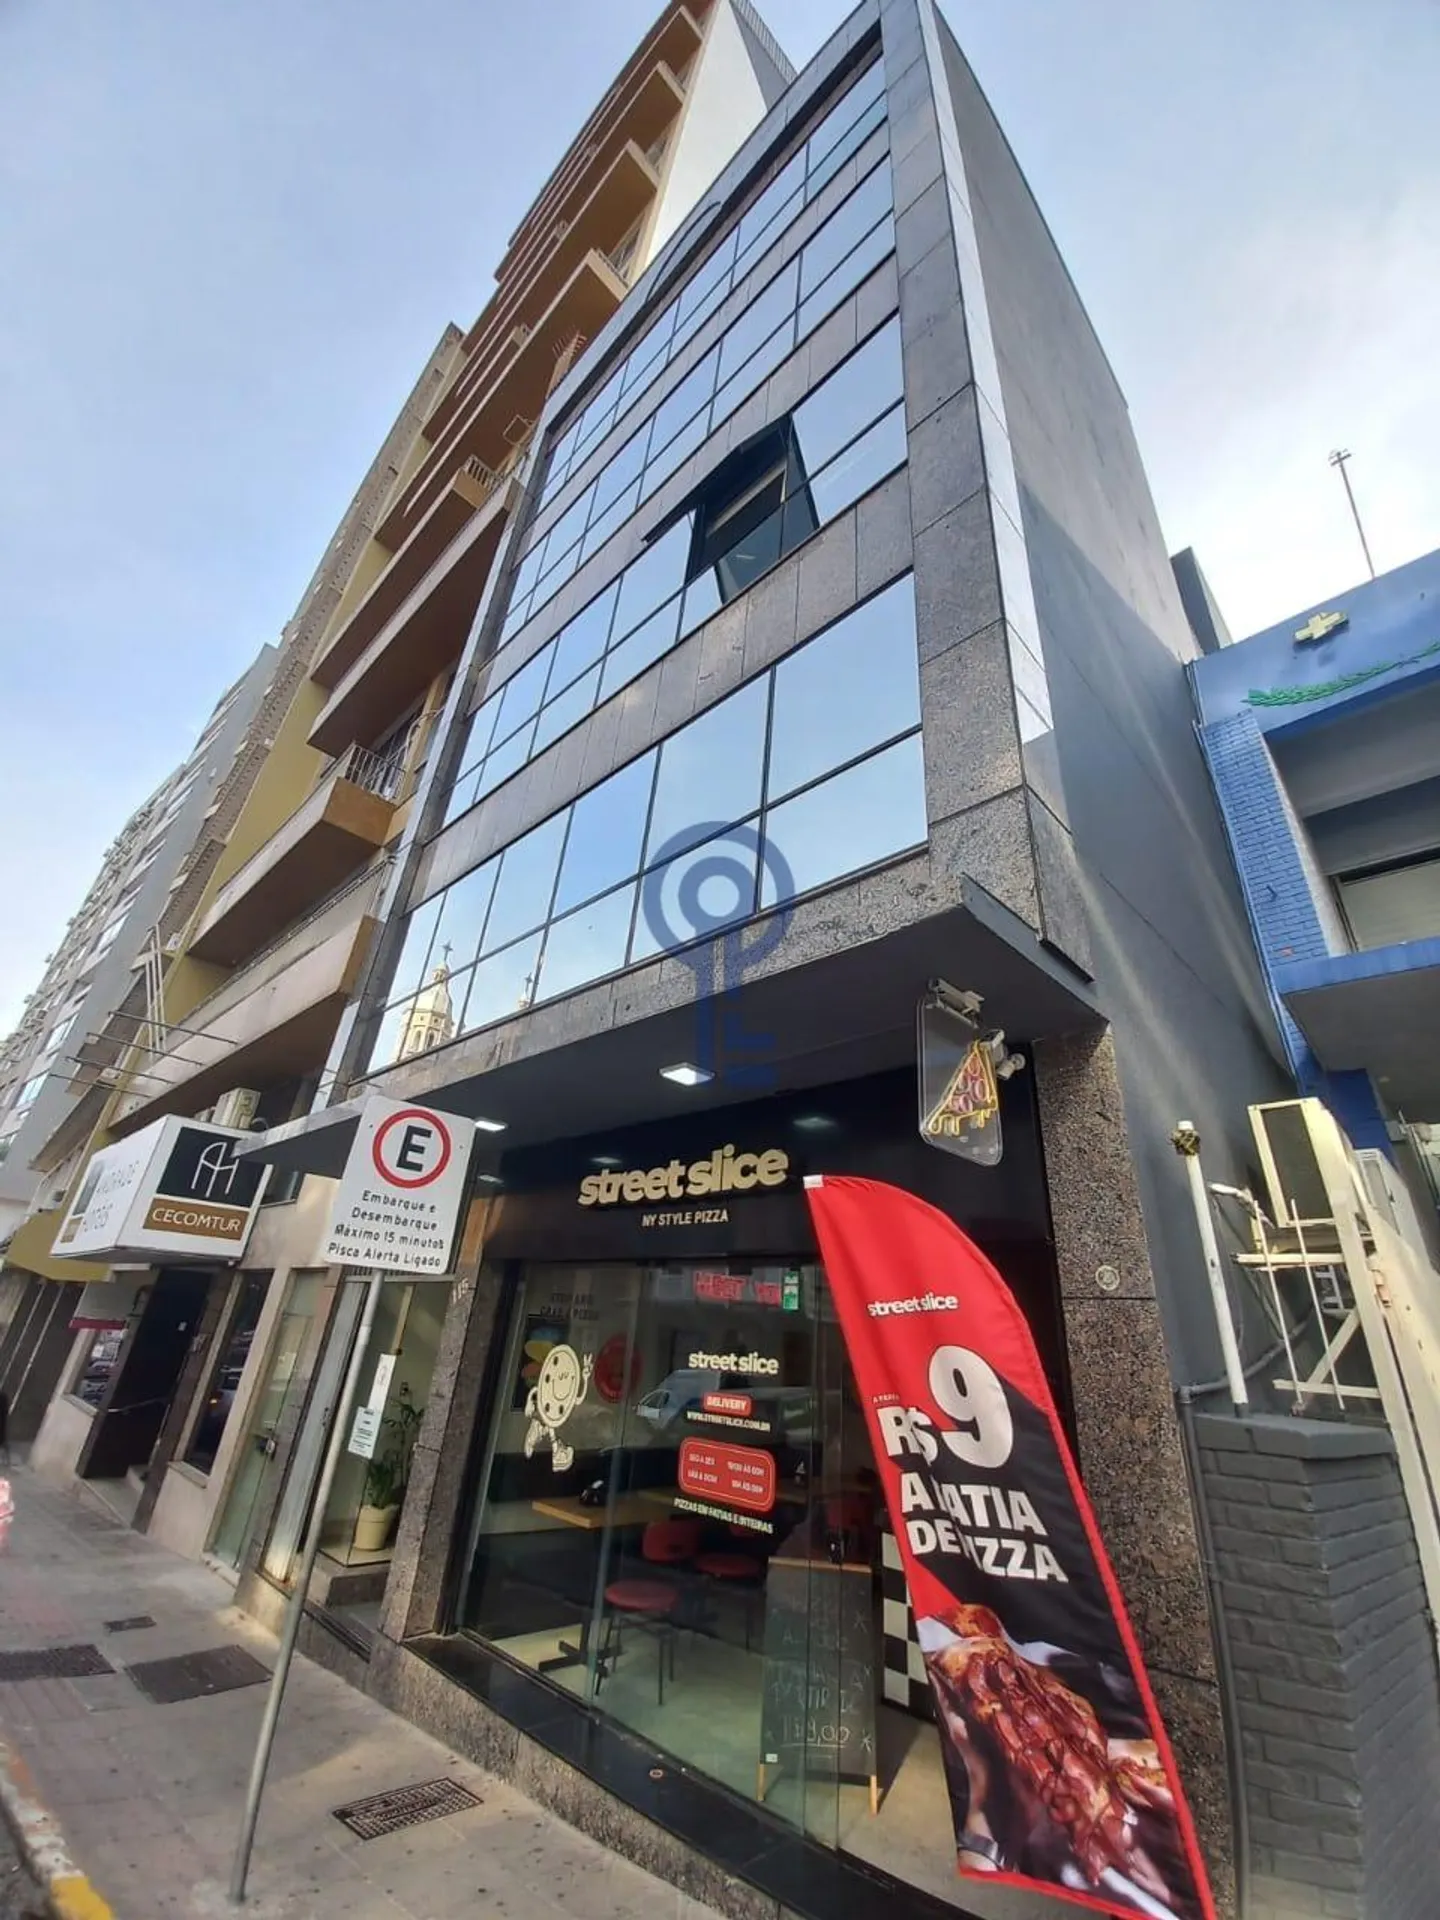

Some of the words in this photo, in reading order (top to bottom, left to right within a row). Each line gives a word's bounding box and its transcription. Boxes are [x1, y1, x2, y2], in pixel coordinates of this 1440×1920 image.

[396, 1125, 433, 1172] E
[578, 1158, 686, 1205] street
[686, 1143, 789, 1196] slice
[362, 1189, 425, 1211] Embarque
[429, 1204, 436, 1213] e
[152, 1207, 241, 1232] CECOMTUR
[351, 1206, 437, 1231] Desembarque
[642, 1213, 657, 1227] NY
[658, 1212, 692, 1226] STYLE
[694, 1208, 729, 1224] PIZZA
[384, 1231, 395, 1243] 15
[399, 1235, 444, 1250] minutos
[328, 1242, 360, 1257] Pisca
[363, 1247, 400, 1263] Alerta
[403, 1252, 441, 1268] Ligado
[688, 1350, 738, 1371] street
[738, 1351, 780, 1374] slice
[706, 1395, 748, 1411] DELIVERY
[901, 1472, 934, 1513] A
[906, 1519, 961, 1555] DE
